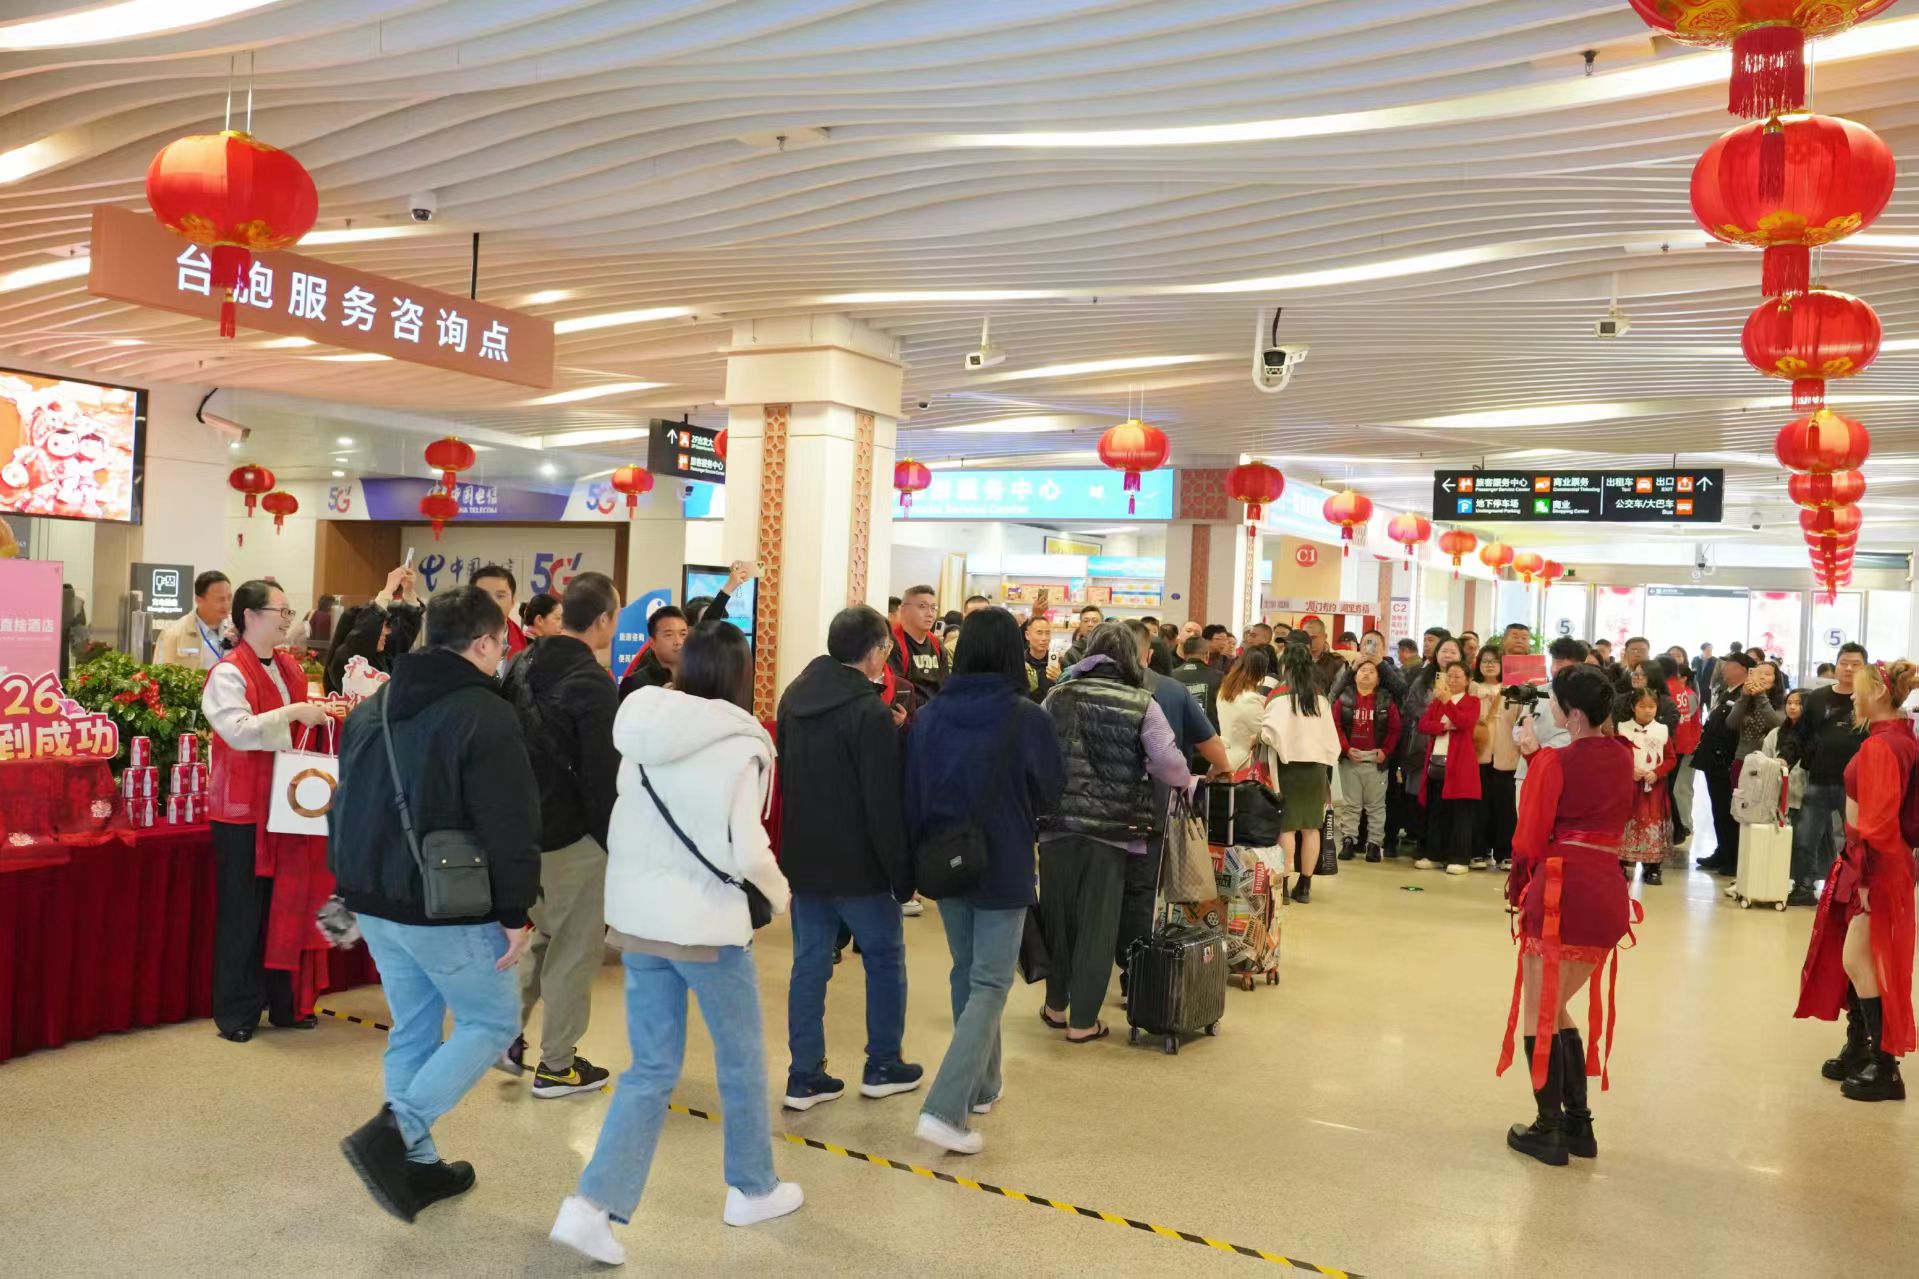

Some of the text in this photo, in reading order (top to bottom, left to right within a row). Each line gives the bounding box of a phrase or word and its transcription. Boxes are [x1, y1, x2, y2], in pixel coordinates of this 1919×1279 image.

[177, 244, 511, 363] 台胞服务咨询点
[1475, 478, 1528, 488] 旅客服务中心
[1606, 477, 1634, 487] 出租车
[1656, 477, 1675, 486] 出口
[1475, 498, 1519, 508] 地下停车场
[1552, 499, 1571, 509] 商业
[1615, 499, 1675, 509] 公交车/大巴车
[1297, 549, 1315, 562] C1
[1392, 603, 1407, 613] C2
[1560, 619, 1571, 634] 5
[1829, 630, 1841, 646] 5
[1676, 690, 1688, 708] 5G
[0, 719, 114, 760] 到成功
